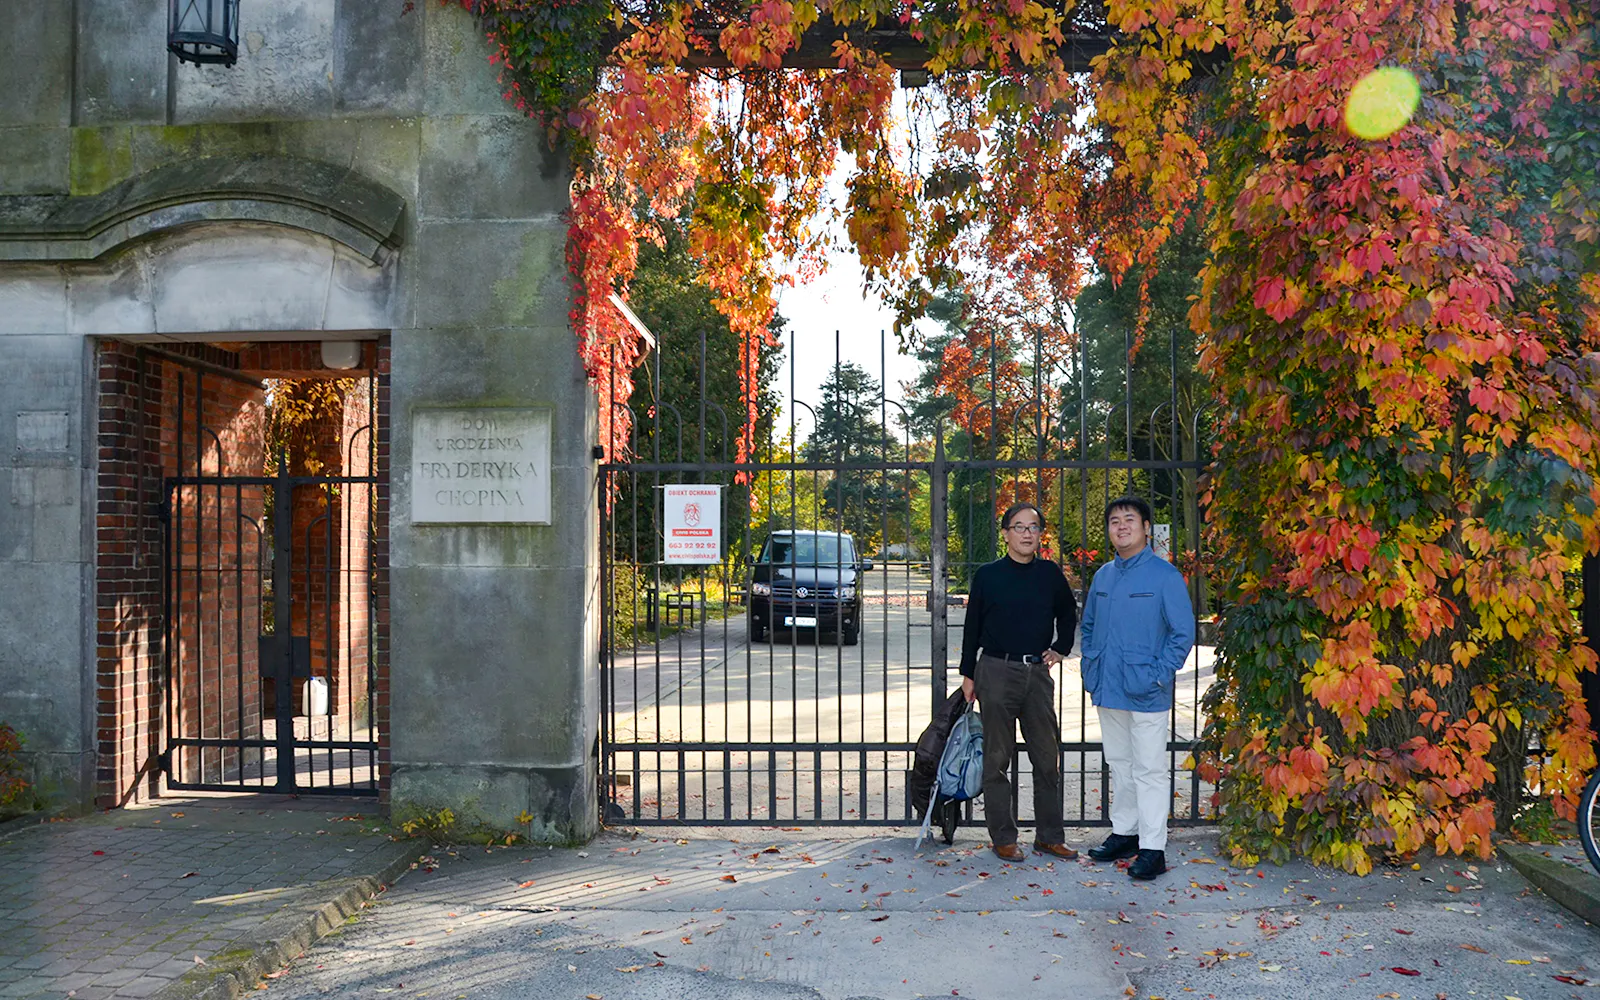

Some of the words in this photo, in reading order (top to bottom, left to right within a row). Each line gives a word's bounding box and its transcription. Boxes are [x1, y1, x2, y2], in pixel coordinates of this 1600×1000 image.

[436, 438, 524, 451] URODZENIA
[420, 461, 538, 479] FRYDERYKA
[435, 489, 525, 506] CHOPINA
